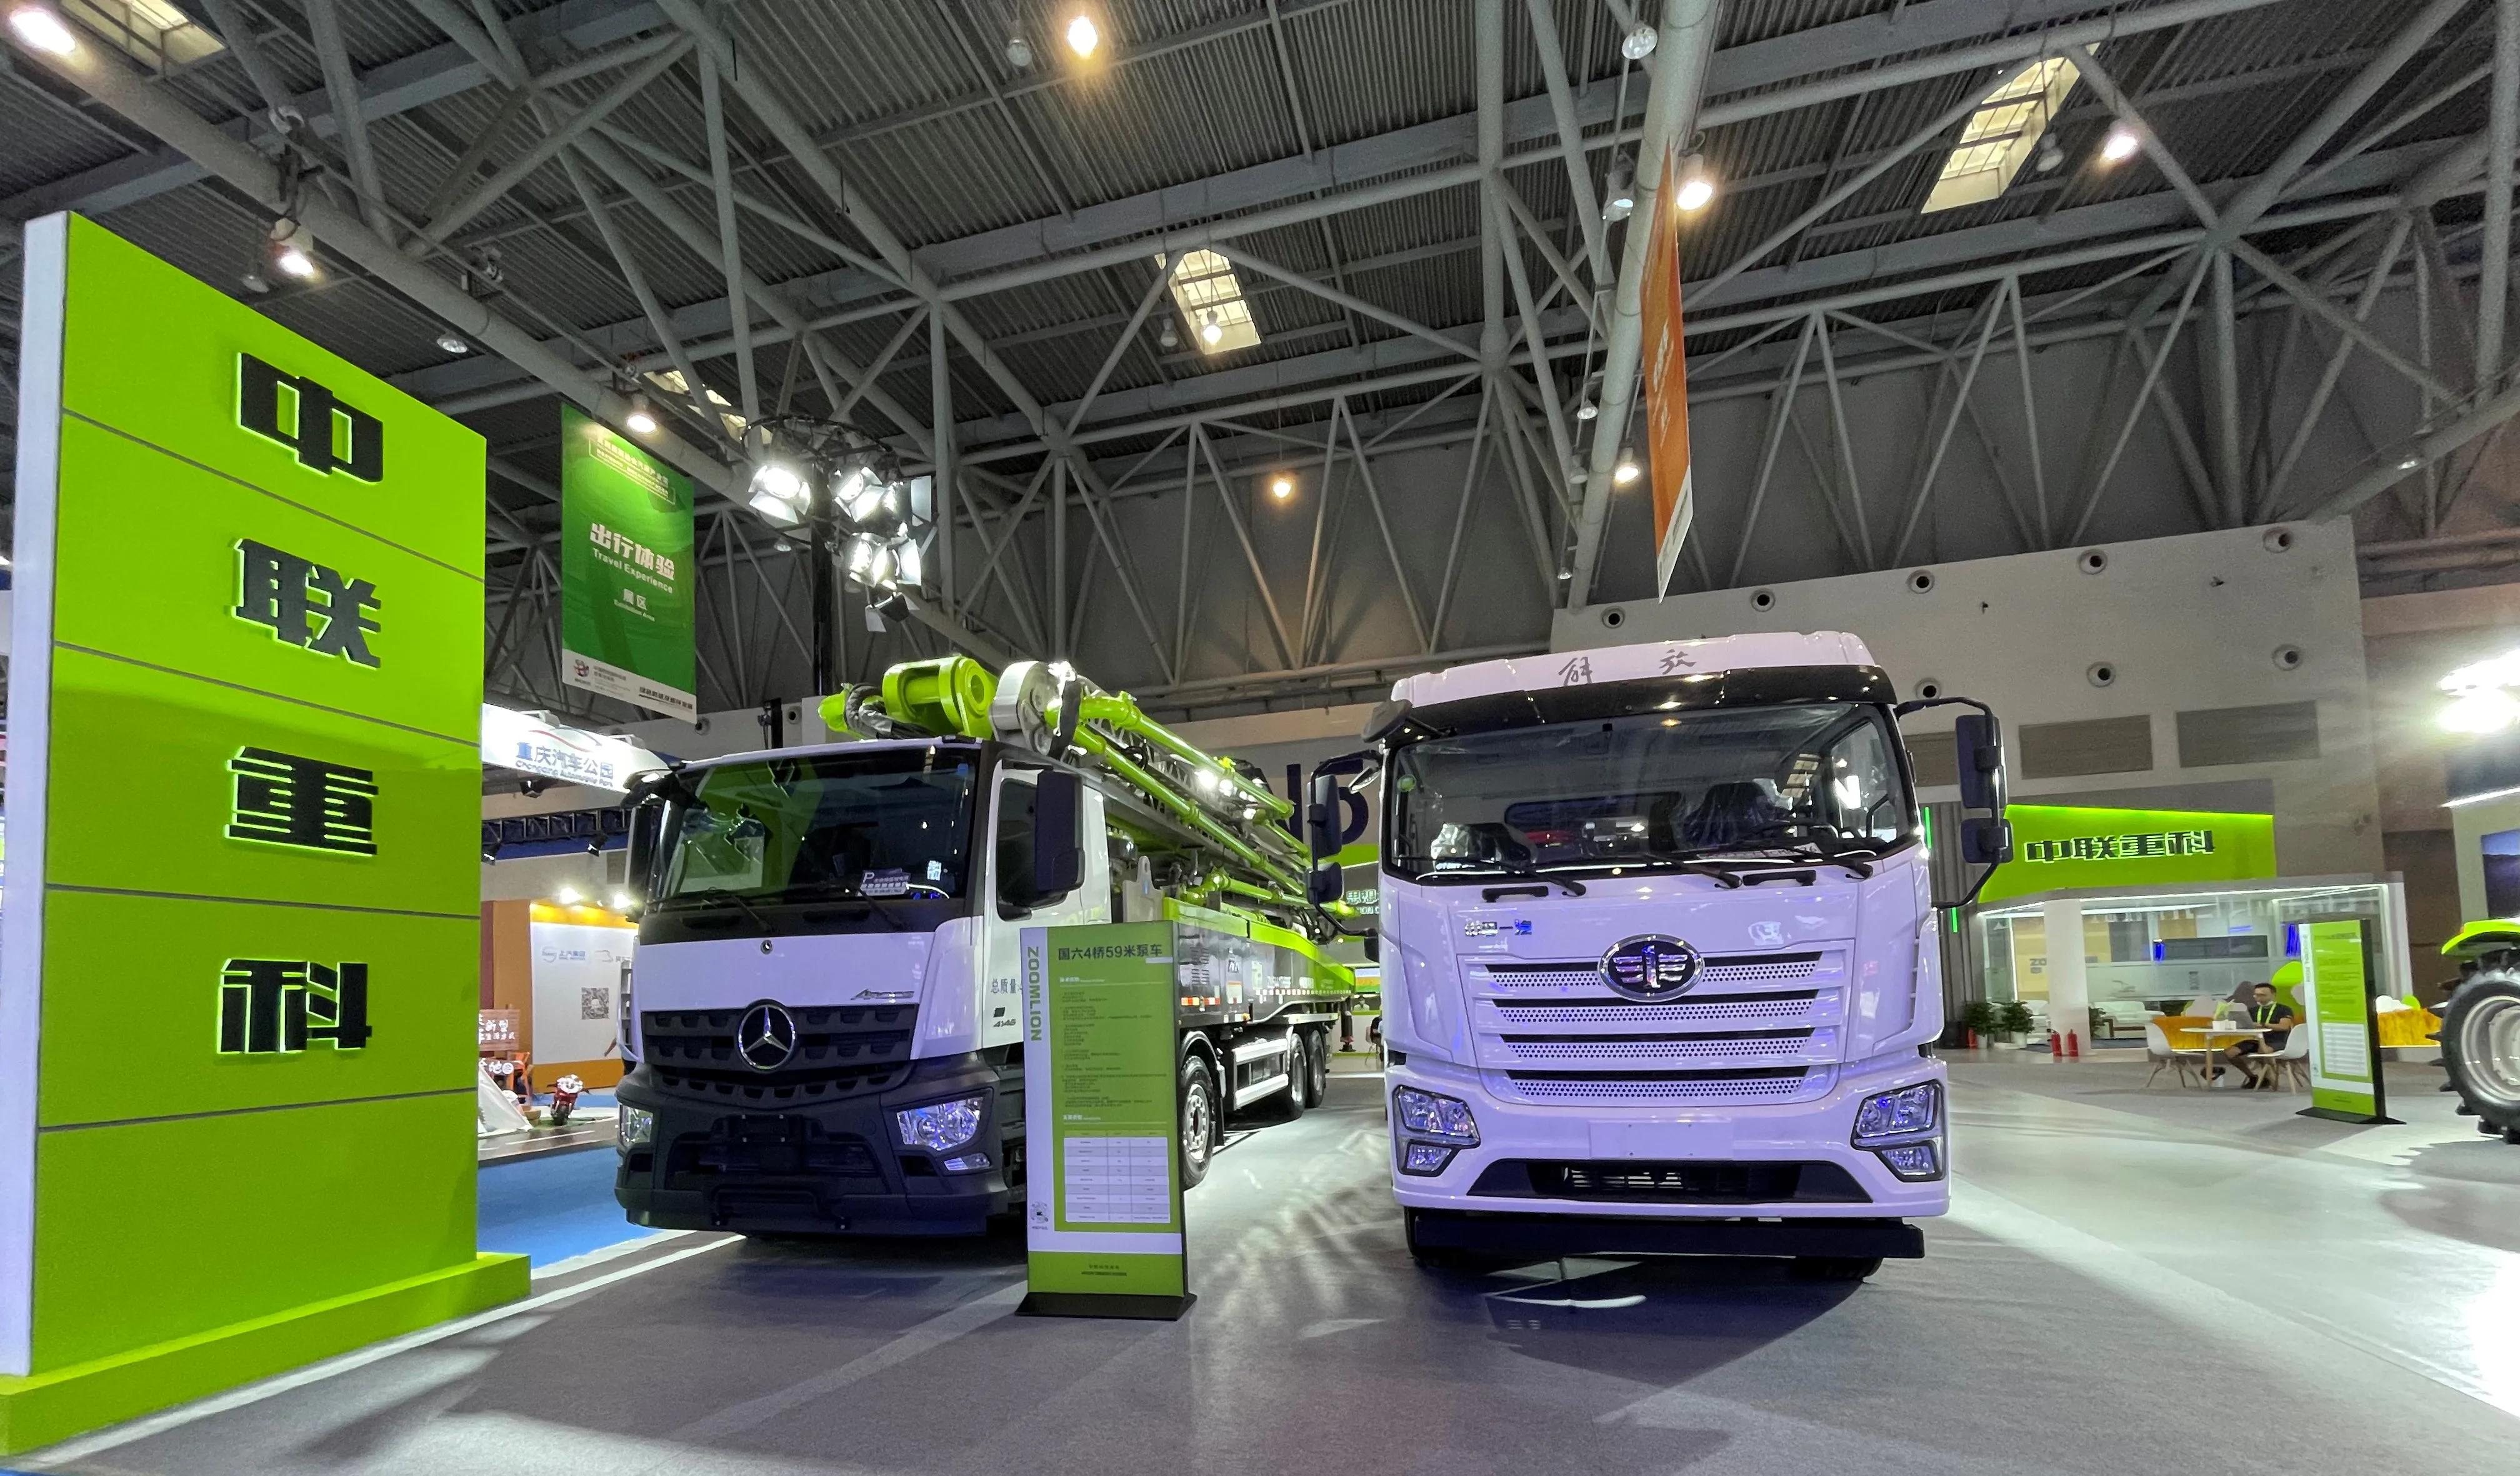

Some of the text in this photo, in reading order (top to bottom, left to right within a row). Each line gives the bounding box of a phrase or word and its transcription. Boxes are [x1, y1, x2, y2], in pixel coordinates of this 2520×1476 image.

[590, 522, 675, 580] 出行体验
[593, 547, 673, 594] Travel Experience
[216, 351, 384, 1055] 中联重科
[516, 742, 614, 779] 重庆汽车公园
[2024, 830, 2214, 864] 中联重科
[1058, 944, 1162, 960] 国六4桥59米泵车
[1028, 946, 1042, 1041] ZOOMLION
